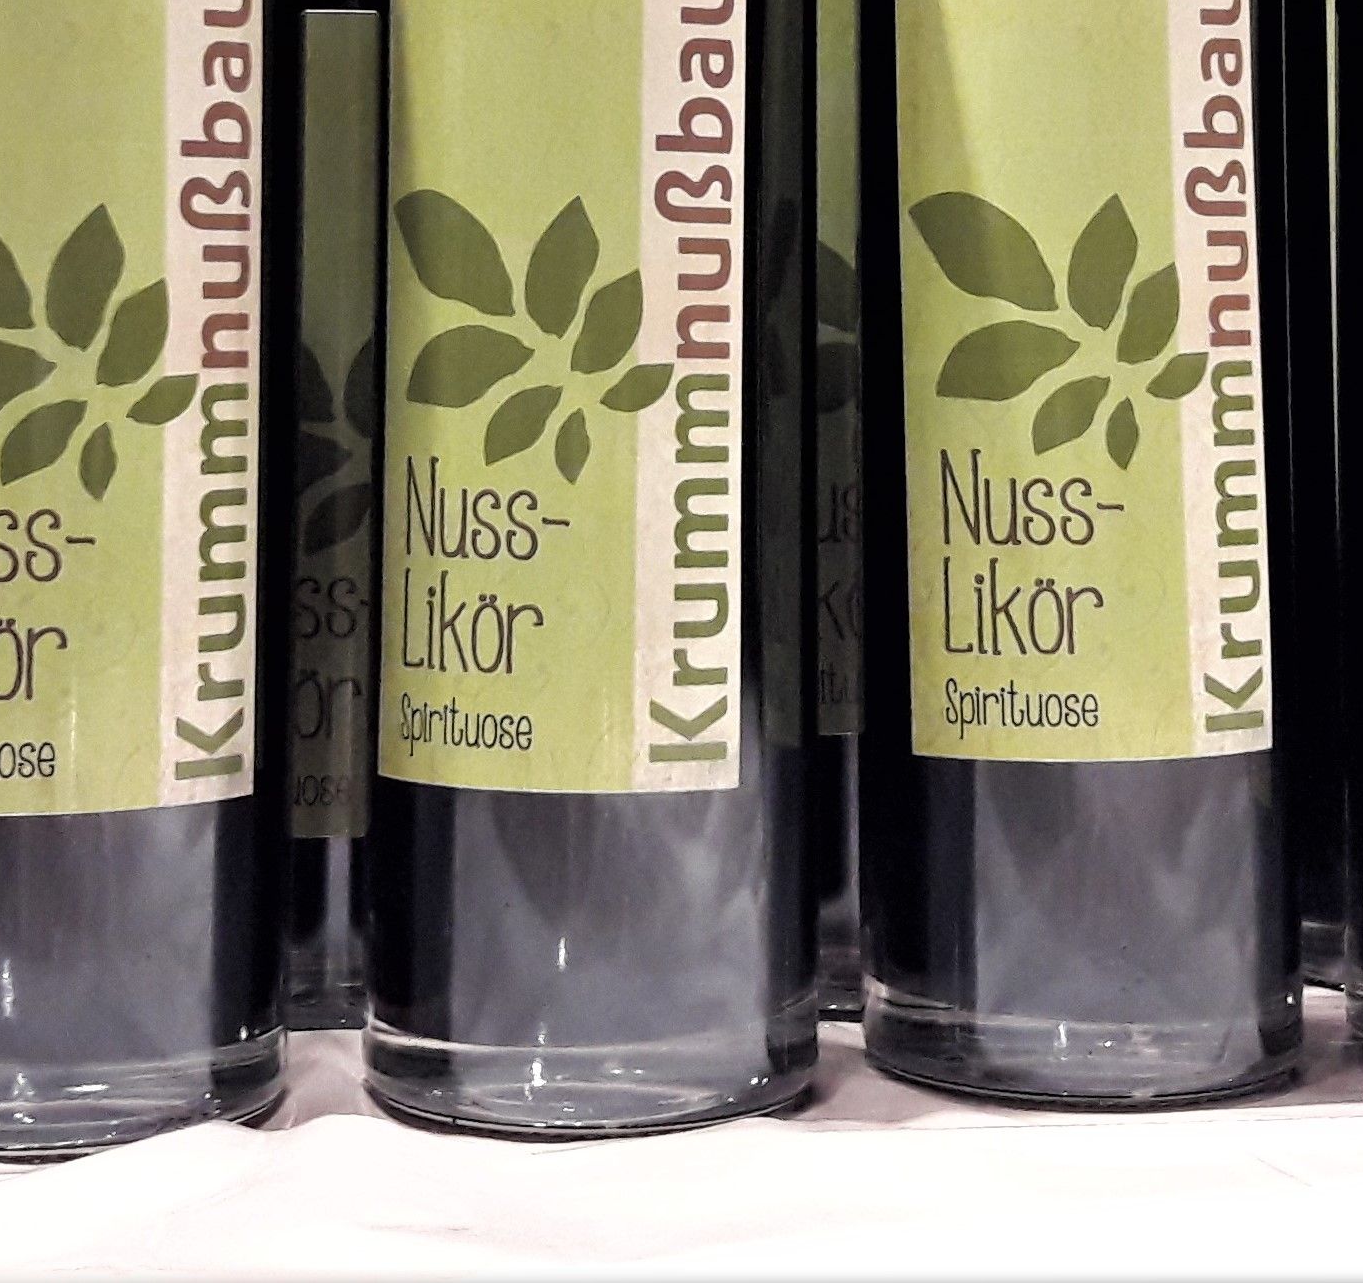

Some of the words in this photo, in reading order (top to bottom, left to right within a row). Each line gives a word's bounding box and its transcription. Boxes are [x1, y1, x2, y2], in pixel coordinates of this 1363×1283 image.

[405, 455, 570, 561] Nuss-
[940, 448, 1124, 546] Nuss-
[402, 568, 544, 674] Likör
[942, 556, 1104, 656] Likör
[401, 692, 532, 757] Spirituose
[945, 678, 1098, 737] Spirituose
